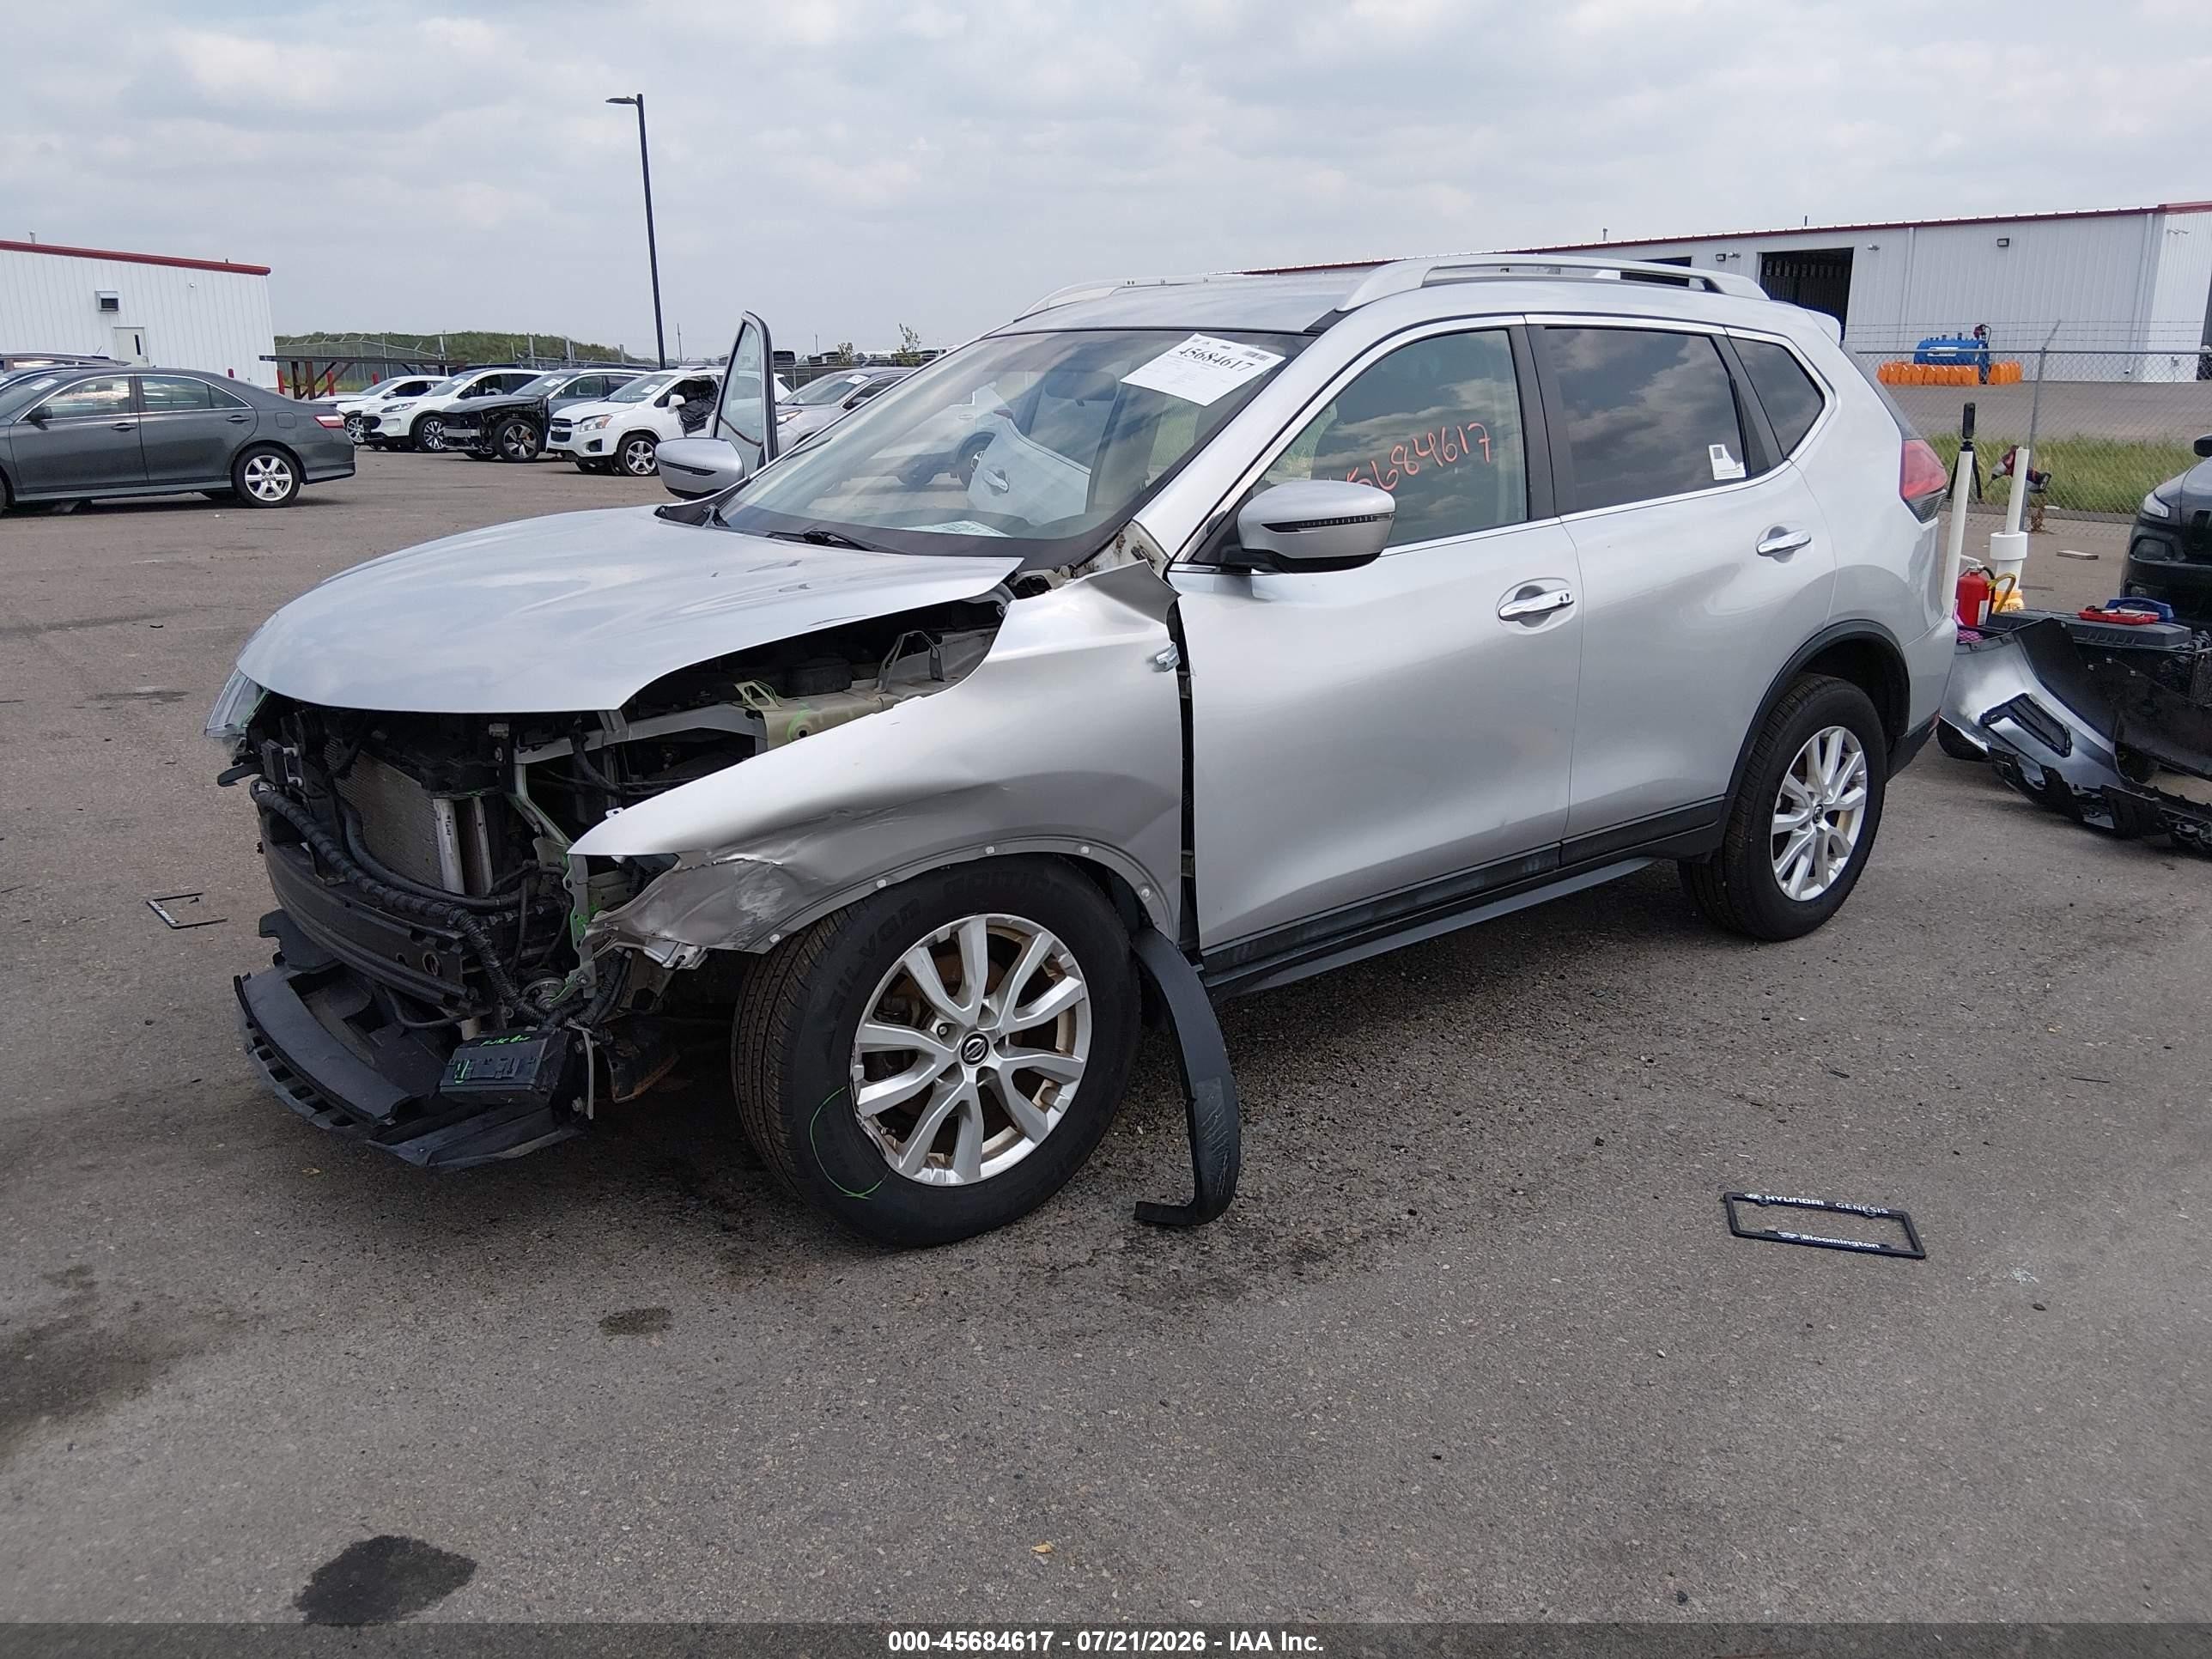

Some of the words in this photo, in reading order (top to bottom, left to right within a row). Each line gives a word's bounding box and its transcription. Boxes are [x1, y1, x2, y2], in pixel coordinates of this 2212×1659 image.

[1177, 346, 1256, 372] 45684617
[1765, 1194, 1825, 1206] HYUNDAI
[1835, 1202, 1889, 1214] GENESIS
[1802, 1234, 1881, 1249] Bloomington
